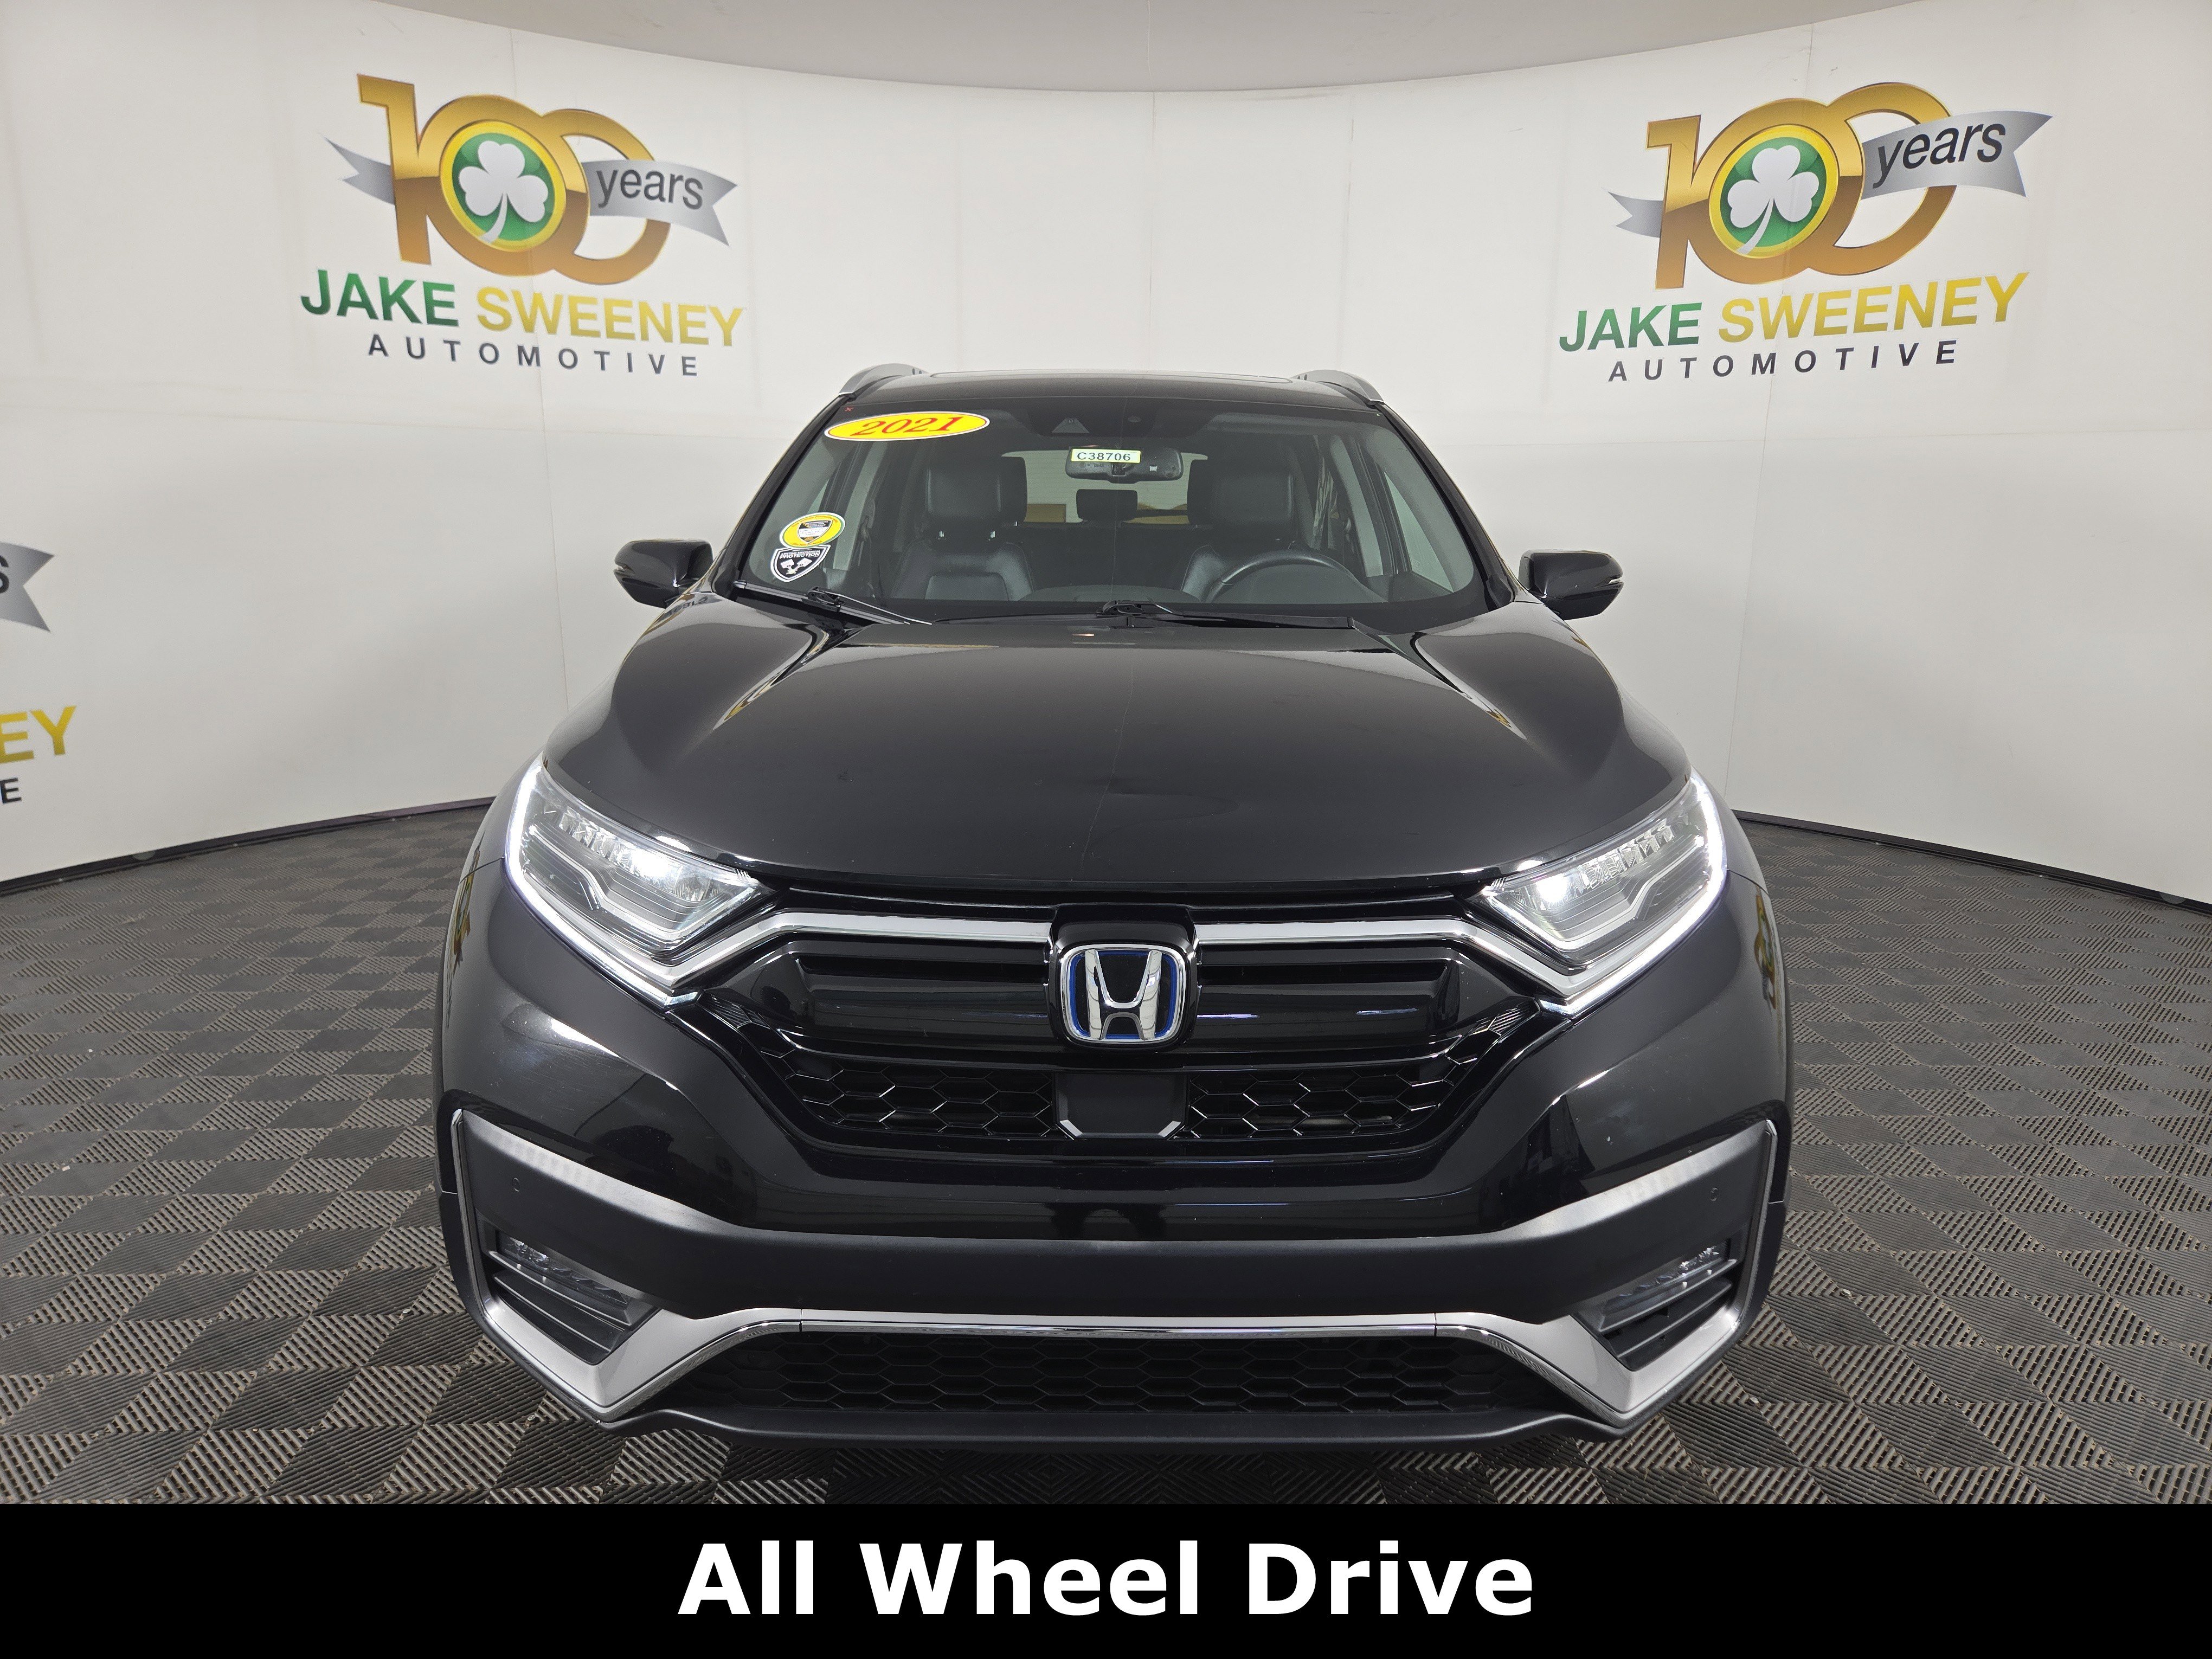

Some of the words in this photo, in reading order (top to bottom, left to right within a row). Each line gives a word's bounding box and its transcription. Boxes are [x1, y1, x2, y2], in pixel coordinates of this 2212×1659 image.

[1872, 123, 2007, 189] years
[596, 164, 704, 210] years
[301, 269, 459, 327] JAKE
[477, 287, 743, 347] SWEENEY
[1559, 303, 1702, 352] JAKE
[1718, 272, 2029, 344] SWEENEY
[368, 334, 698, 377] AUTOMOTIVE
[1608, 340, 1958, 382] AUTOMOTIVE
[850, 416, 964, 436] 2021
[1077, 452, 1131, 461] C38706
